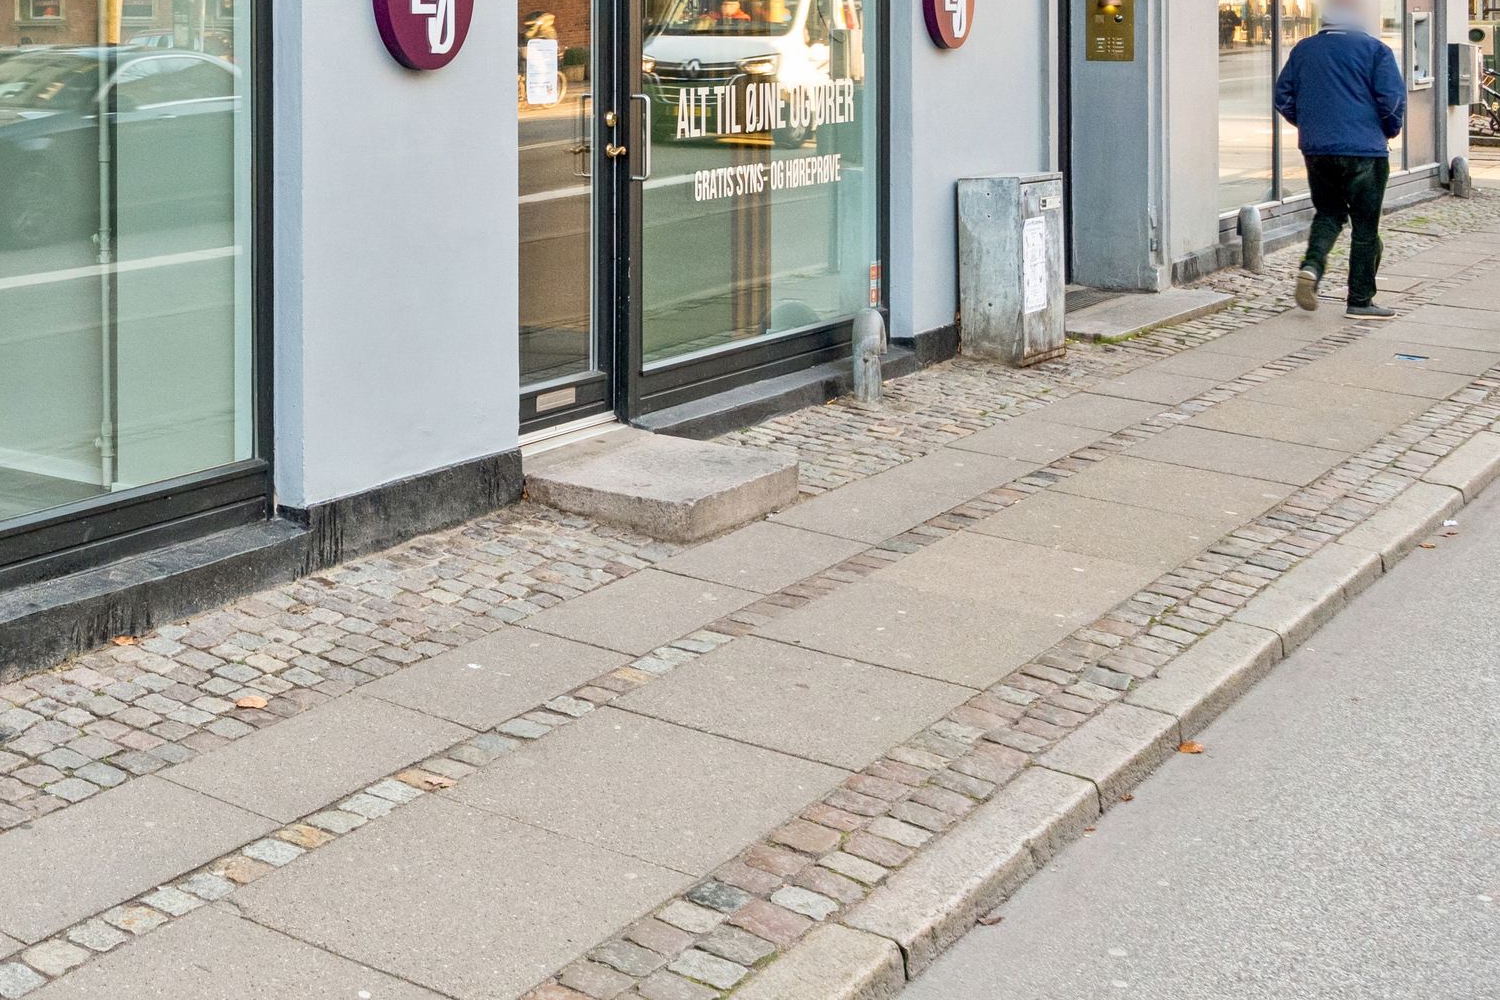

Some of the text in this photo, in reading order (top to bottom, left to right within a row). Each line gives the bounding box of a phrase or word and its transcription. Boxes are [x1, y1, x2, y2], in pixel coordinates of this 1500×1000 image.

[676, 78, 854, 139] ALT TIL ØJNE OG ØRER
[694, 153, 842, 202] GRATIS SYNS- OG HØREPRØVE
